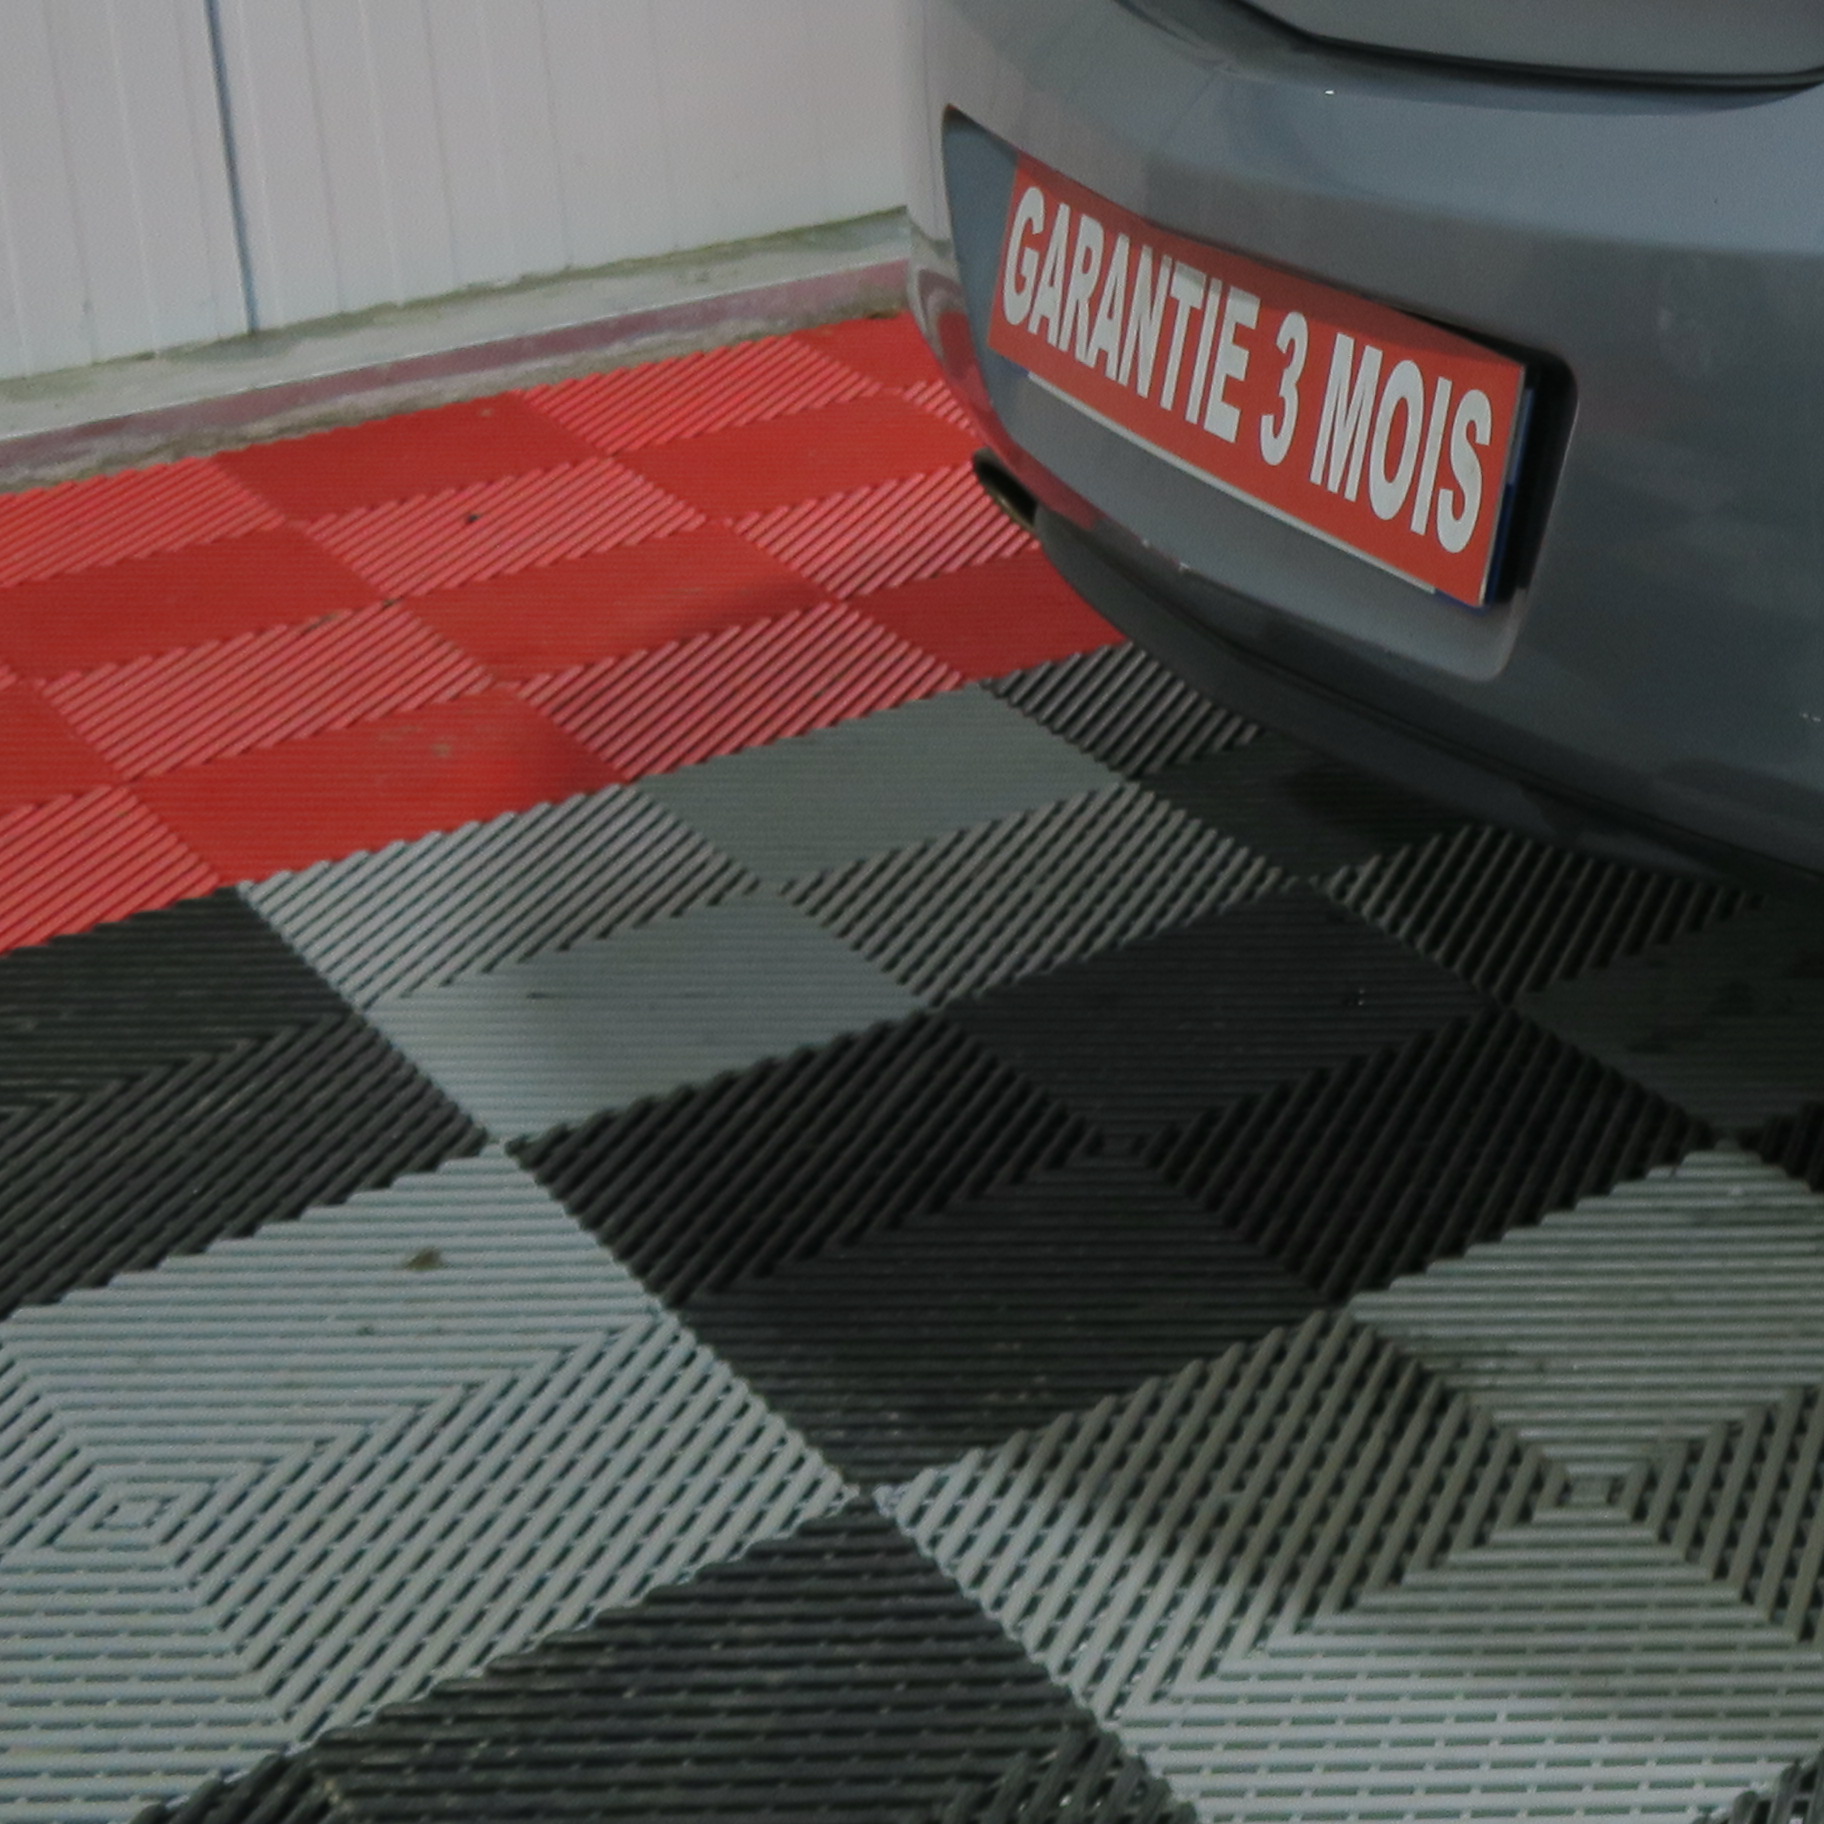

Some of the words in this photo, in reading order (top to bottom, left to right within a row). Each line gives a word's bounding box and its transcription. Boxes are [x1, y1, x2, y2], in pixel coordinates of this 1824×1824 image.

[1003, 187, 1260, 443] GARANTIE
[1260, 312, 1308, 466] 3
[1310, 333, 1491, 554] MOIS
